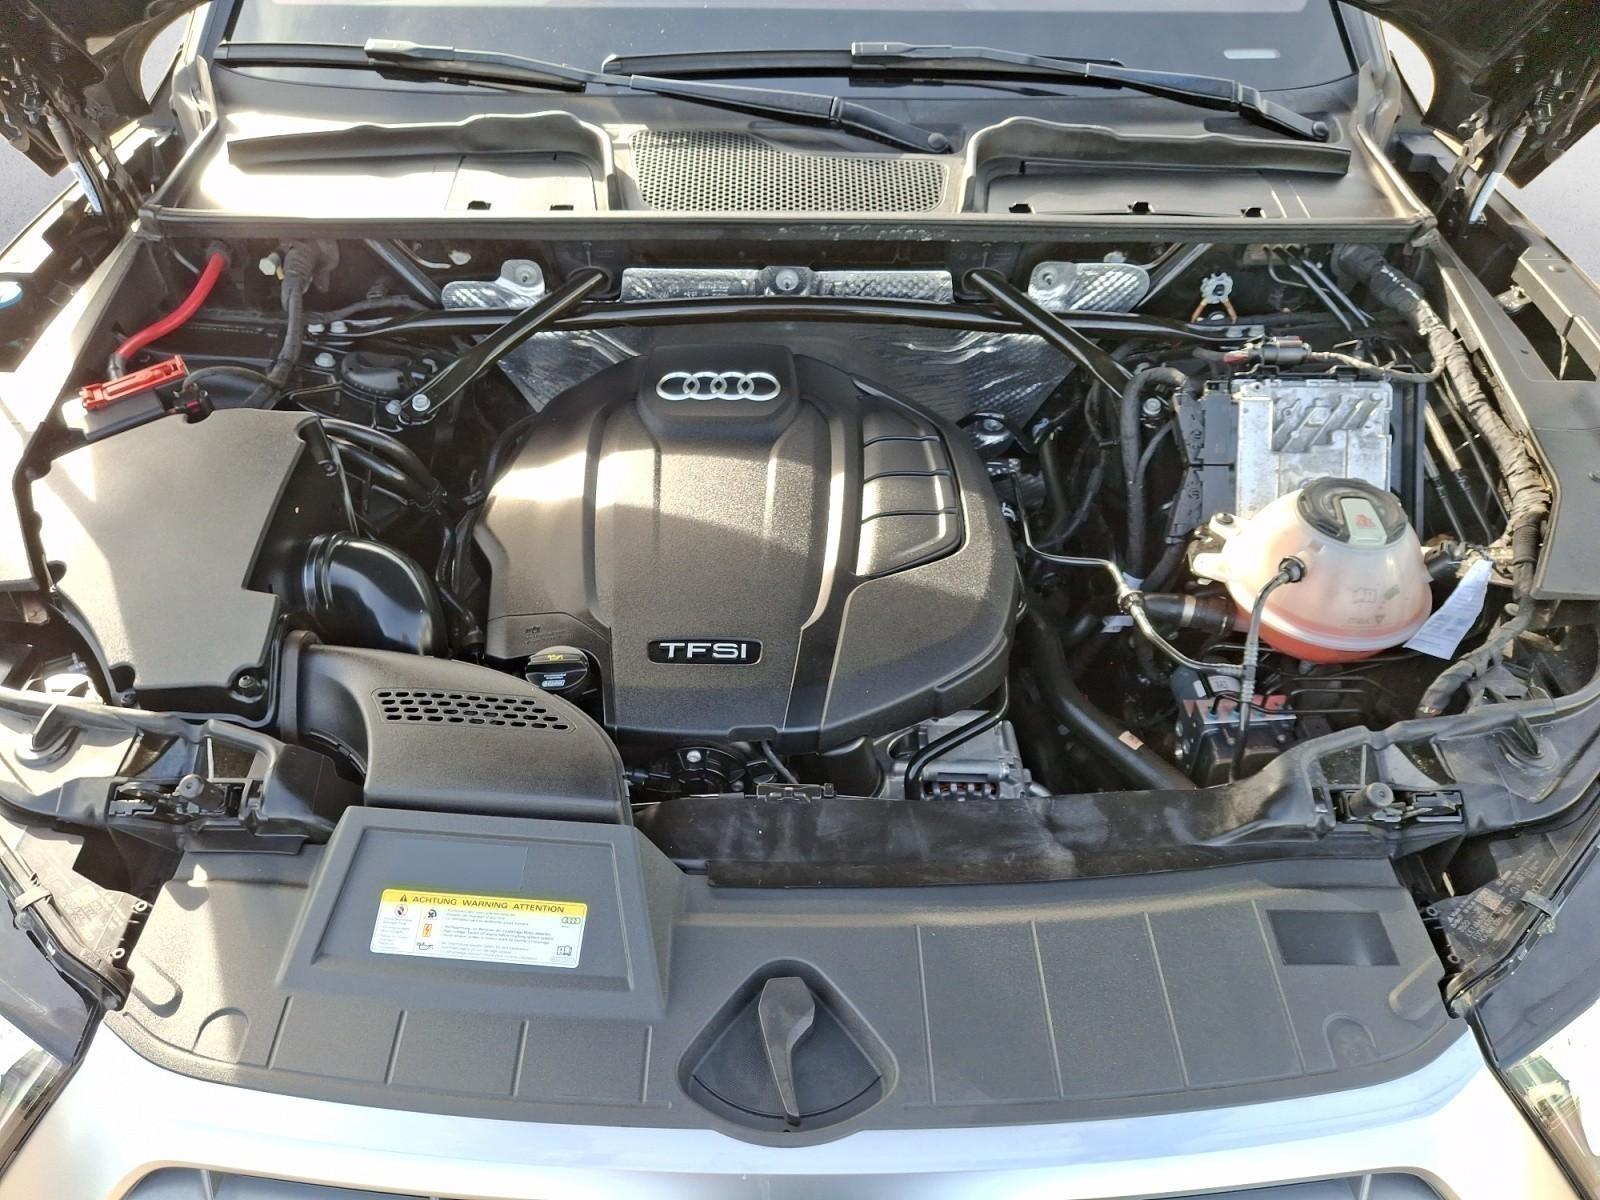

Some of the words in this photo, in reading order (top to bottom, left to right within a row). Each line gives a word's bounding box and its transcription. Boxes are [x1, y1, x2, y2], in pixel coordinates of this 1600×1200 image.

[659, 642, 747, 659] TFSI
[412, 895, 457, 906] ACHTUNG
[462, 899, 508, 909] WARNING
[512, 903, 565, 913] ATTENTION
